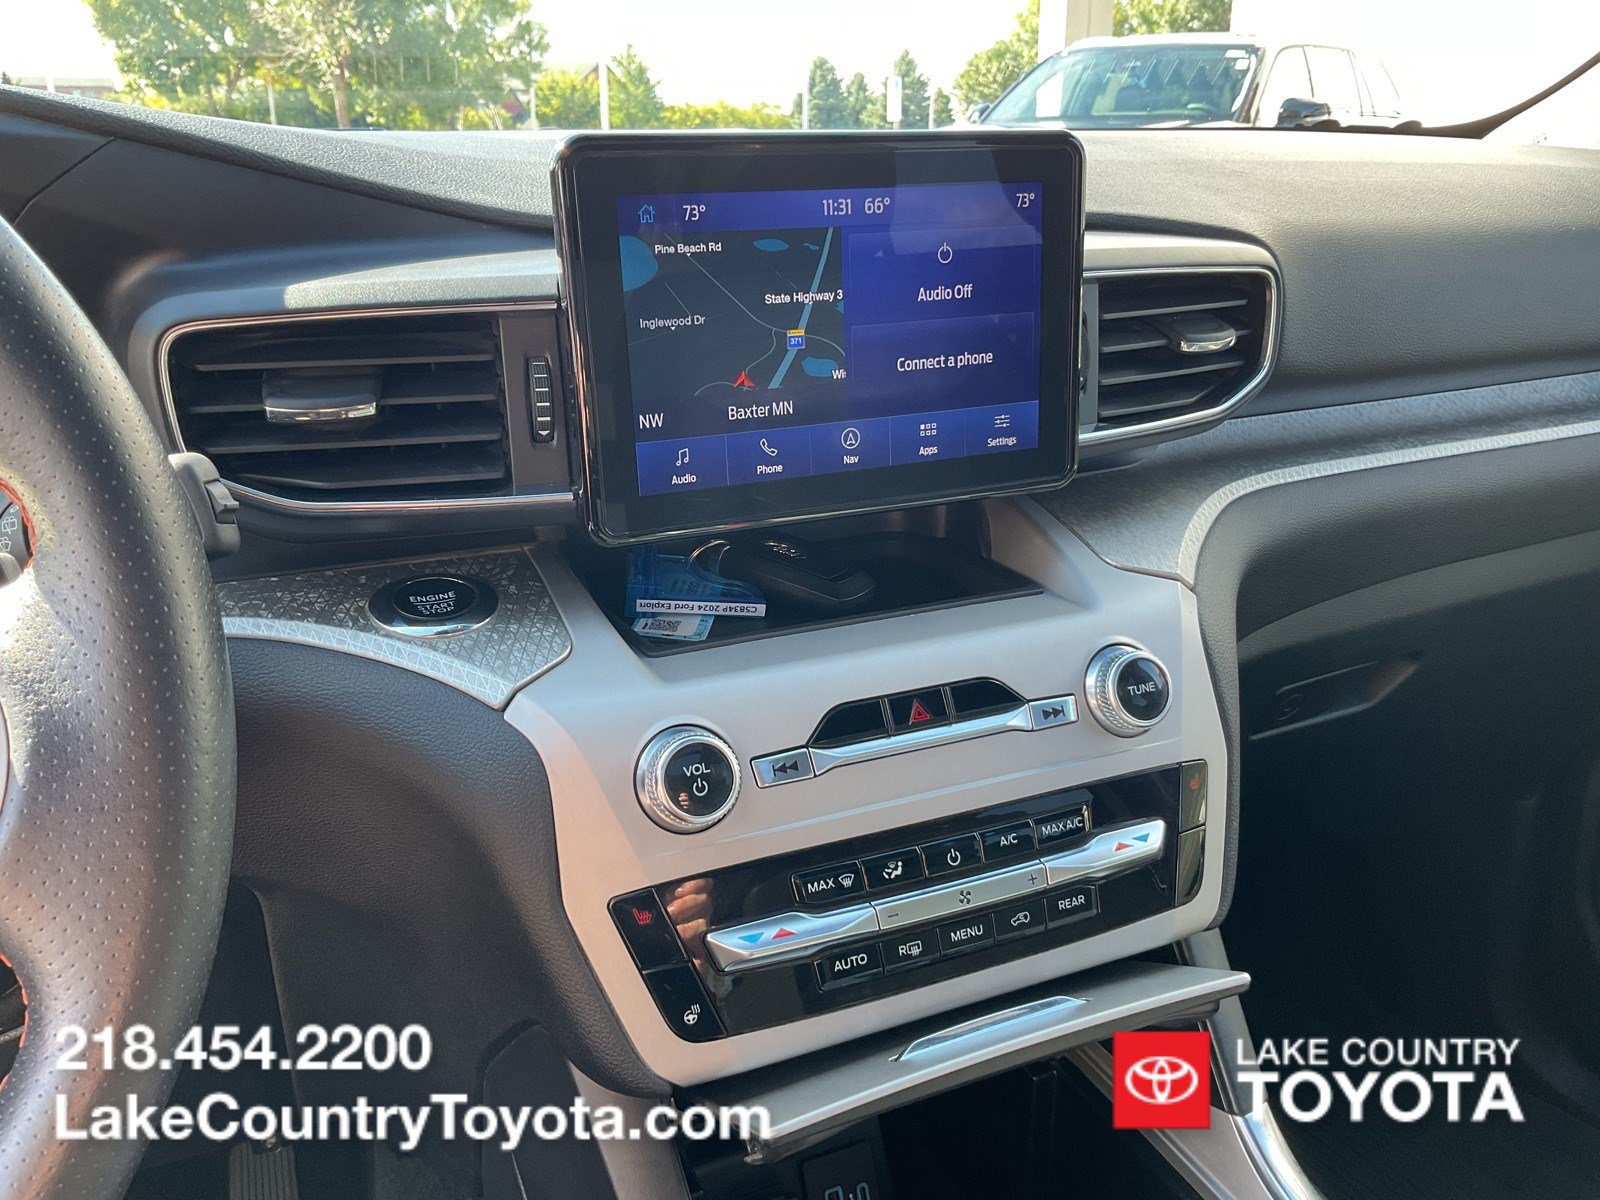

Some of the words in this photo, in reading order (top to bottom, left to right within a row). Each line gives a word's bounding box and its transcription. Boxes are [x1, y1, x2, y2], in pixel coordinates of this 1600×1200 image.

[822, 199, 852, 216] 11:31
[864, 197, 891, 214] 66°
[1016, 193, 1035, 208] 73°
[683, 204, 706, 221] 73°
[654, 244, 675, 254] Pine
[677, 243, 706, 253] Beach
[708, 242, 722, 252] Rd
[764, 294, 791, 305] State
[793, 291, 835, 305] Highway
[917, 286, 952, 302] Audio
[954, 284, 973, 299] Off
[639, 315, 692, 330] Inglewood
[694, 315, 706, 326] Dr
[790, 337, 802, 345] 371
[896, 354, 946, 373] Connect
[947, 355, 955, 368] a
[957, 352, 994, 369] phone
[728, 404, 770, 421] Baxter
[772, 401, 794, 417] MN
[639, 412, 664, 430] NW
[987, 436, 1017, 448] Settings
[918, 445, 938, 456] Apps
[843, 455, 859, 465] Nav
[756, 463, 783, 475] Phone
[671, 473, 697, 486] Audio
[408, 591, 456, 603] ENGINE
[418, 601, 454, 610] START
[423, 606, 454, 614] STOP
[674, 602, 695, 611] Ford
[697, 604, 720, 612] 2024
[722, 605, 758, 614] C5834P
[1127, 681, 1156, 696] TUNE
[682, 762, 711, 777] VOL
[1042, 822, 1065, 836] MAX
[1064, 815, 1083, 830] A/C
[999, 832, 1018, 847] A/C
[807, 877, 836, 894] MAX
[1057, 893, 1086, 911] REAR
[950, 924, 984, 943] MENU
[833, 953, 868, 973] AUTO
